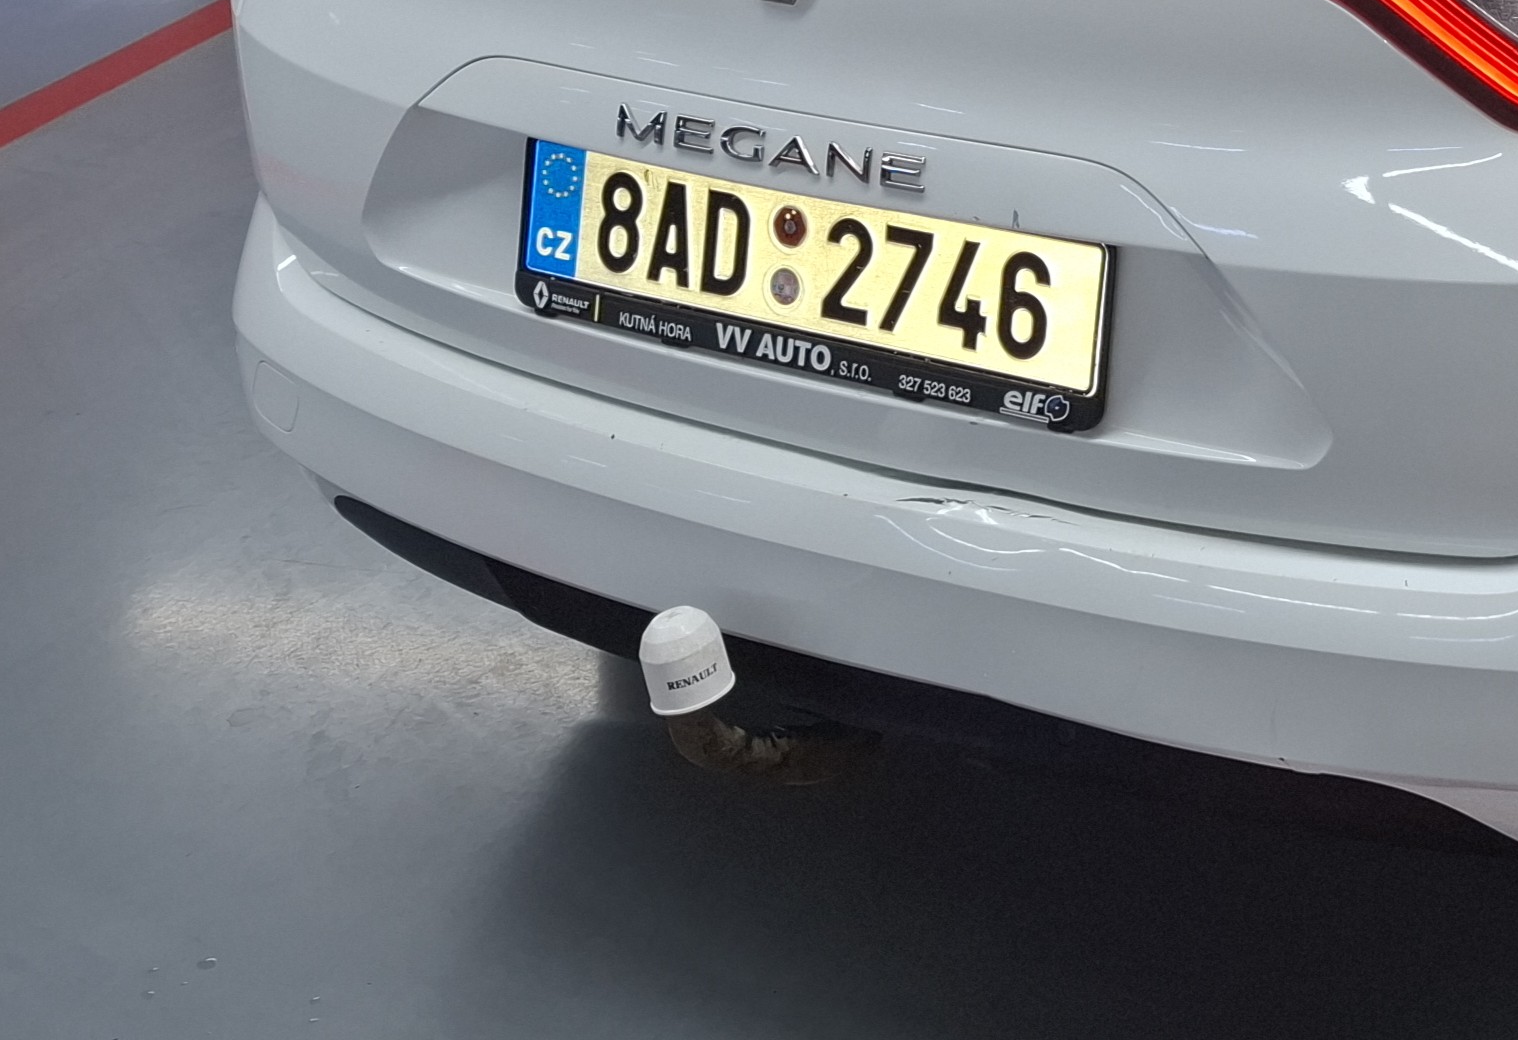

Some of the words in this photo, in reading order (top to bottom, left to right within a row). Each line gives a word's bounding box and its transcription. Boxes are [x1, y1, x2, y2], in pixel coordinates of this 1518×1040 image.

[616, 103, 927, 193] MEGANE
[534, 226, 573, 263] CZ
[596, 170, 752, 298] 8AD
[820, 216, 1054, 361] 2746
[551, 293, 590, 309] RENAULT
[619, 312, 656, 334] KUTNÁ
[658, 321, 692, 342] HORA
[715, 322, 752, 353] VV
[839, 360, 872, 382] s.r.o.
[898, 374, 922, 392] 327
[923, 380, 946, 398] 523
[948, 385, 971, 403] 623
[1003, 390, 1046, 414] elf
[666, 662, 718, 691] RENAULT
